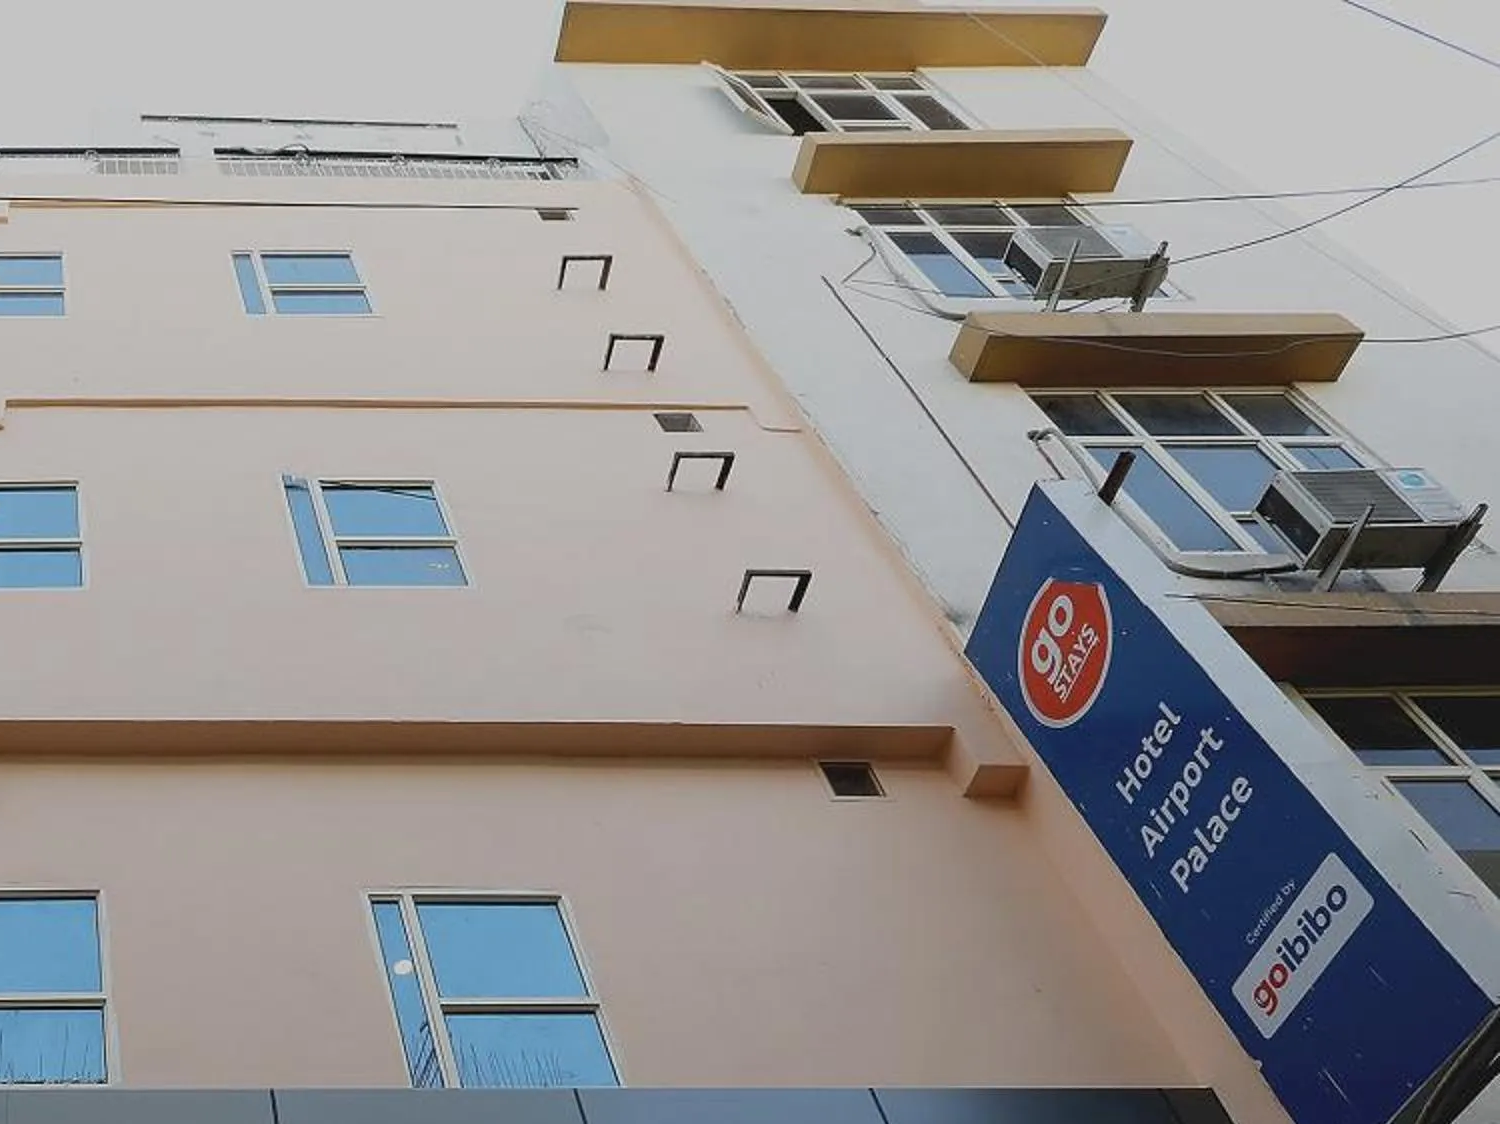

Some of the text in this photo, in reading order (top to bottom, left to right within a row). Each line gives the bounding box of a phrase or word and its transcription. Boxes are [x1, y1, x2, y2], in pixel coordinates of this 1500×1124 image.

[1031, 594, 1074, 685] go
[1053, 623, 1100, 701] STAYS
[1115, 701, 1182, 805] Hotel
[1140, 726, 1224, 859] Airport
[1169, 776, 1253, 894] Palace
[1245, 878, 1298, 946] Certified by
[1253, 884, 1348, 1017] goibibo
